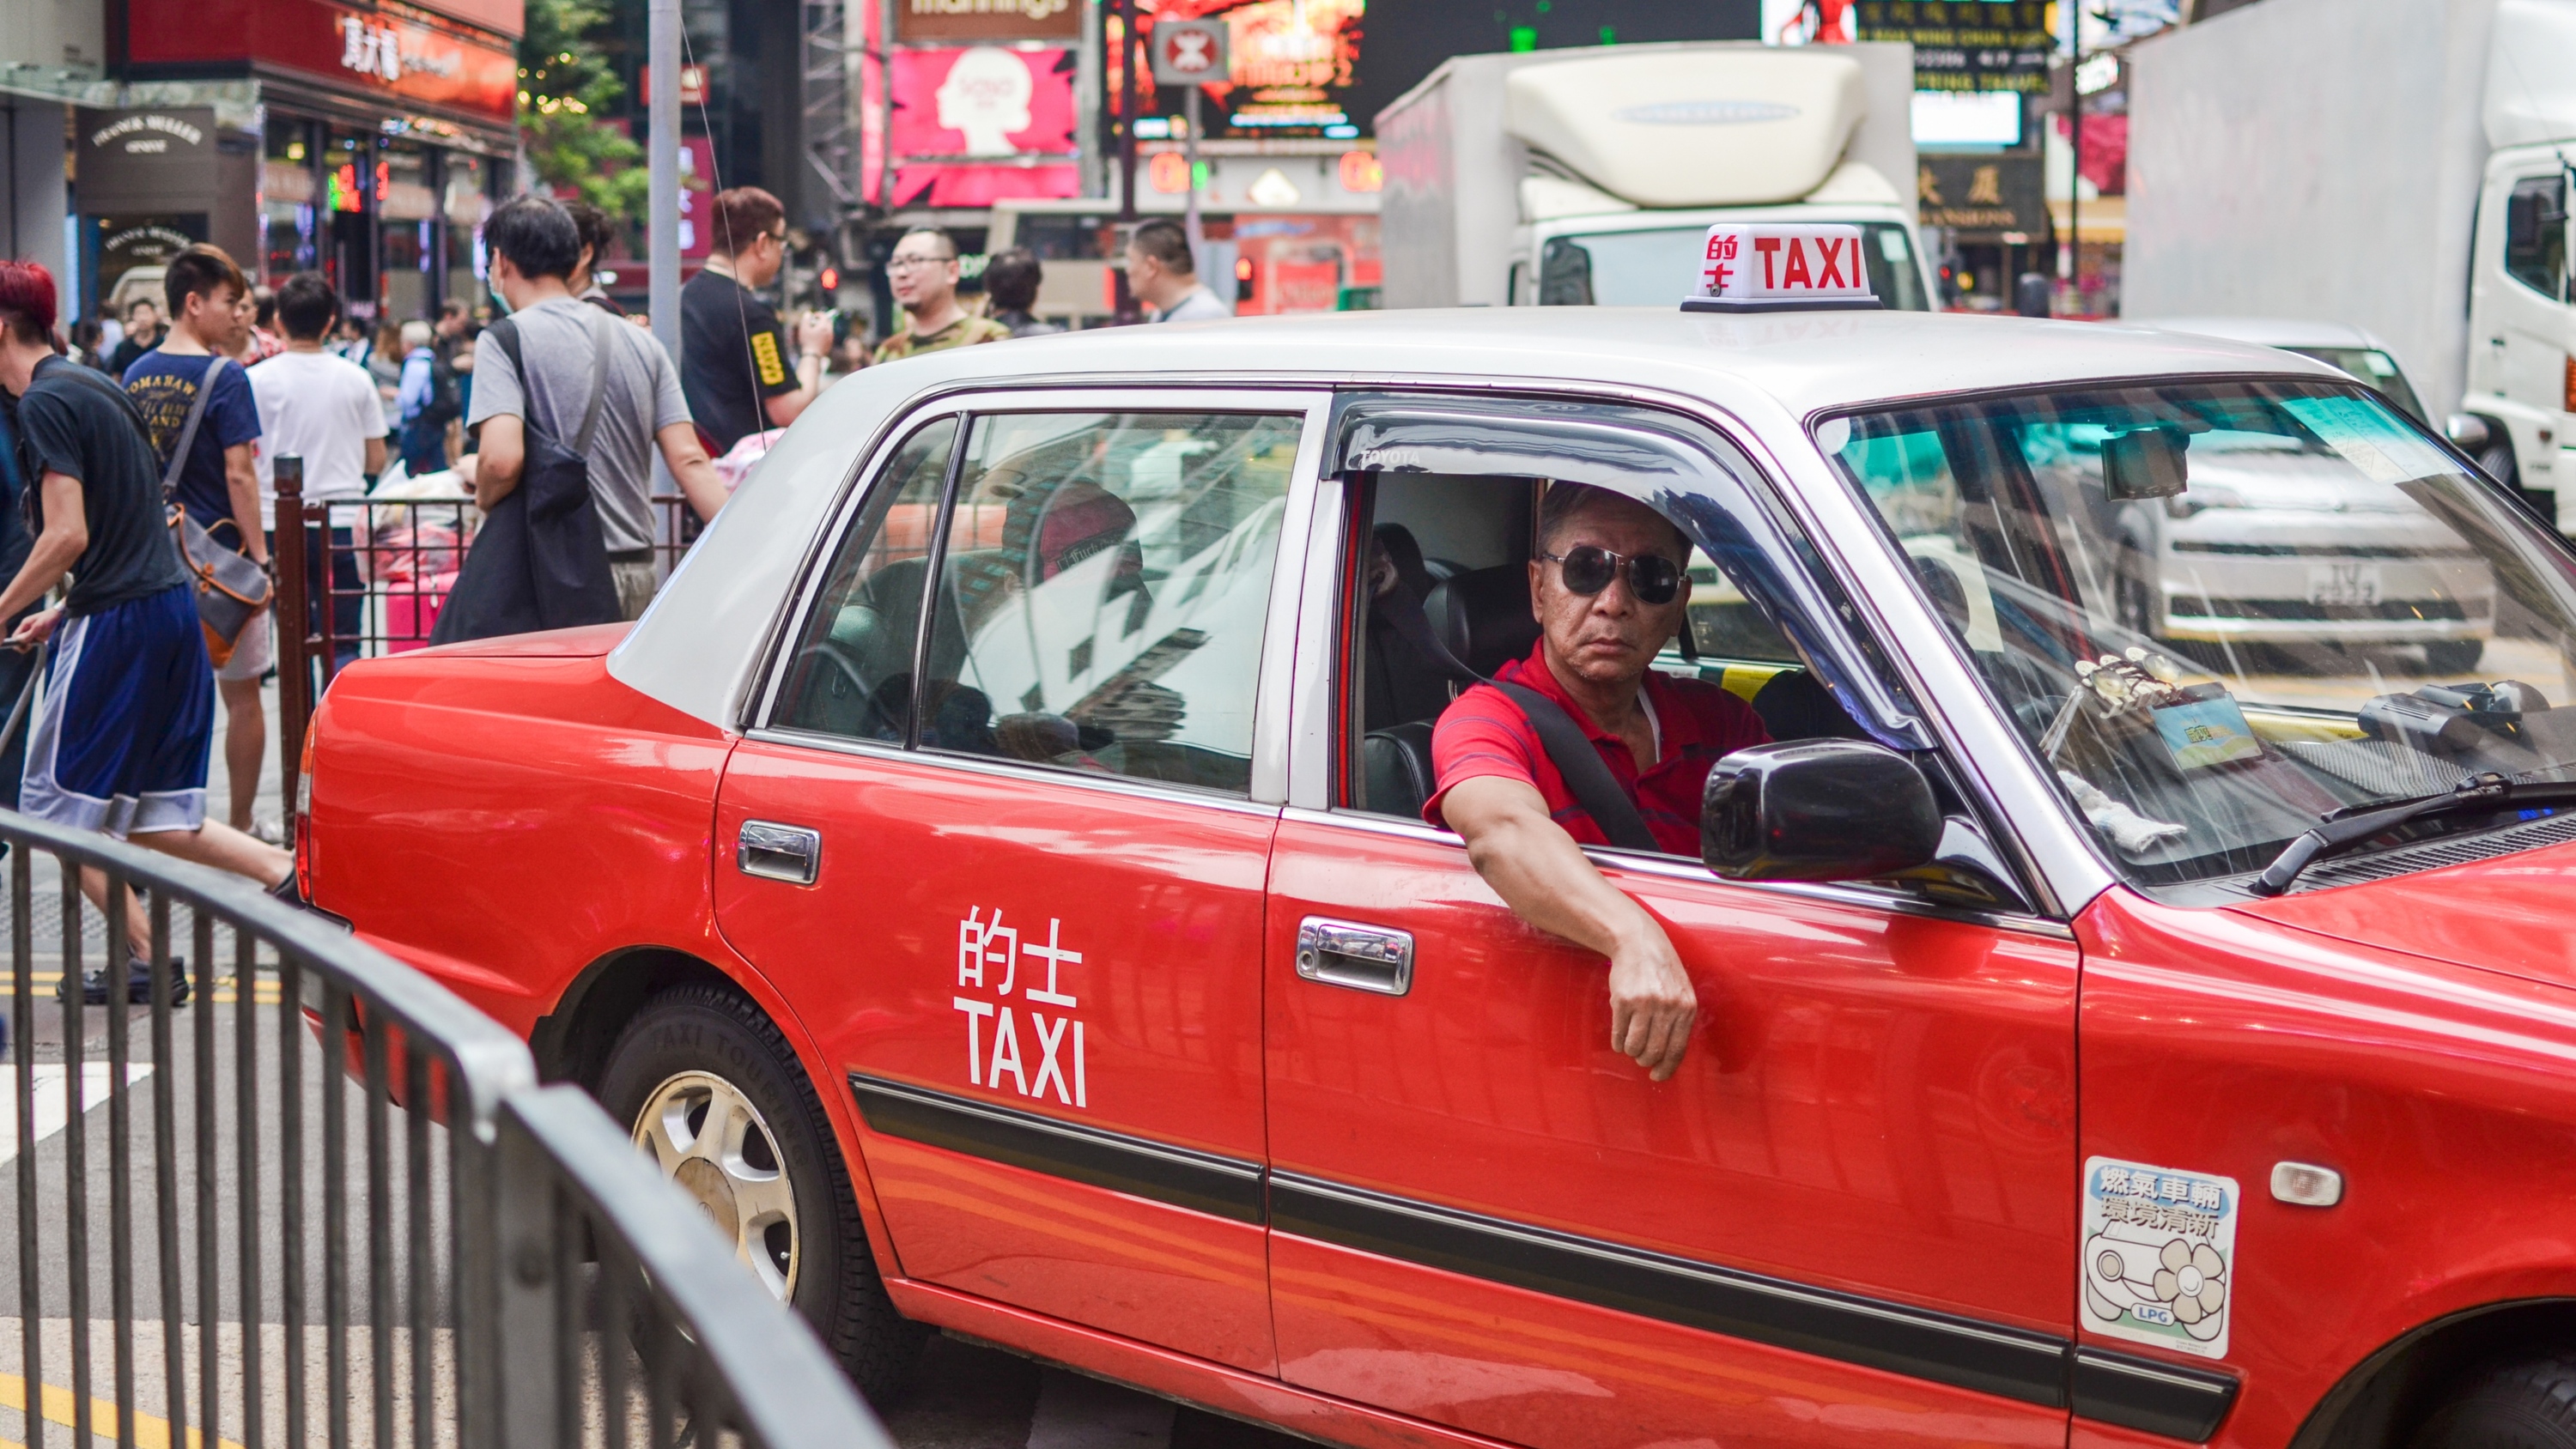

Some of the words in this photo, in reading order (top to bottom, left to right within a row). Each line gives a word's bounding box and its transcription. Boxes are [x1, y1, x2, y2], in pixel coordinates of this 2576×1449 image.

[1704, 234, 1739, 288] 的士
[1754, 238, 1861, 289] TAXI
[127, 374, 198, 403] OMAHAW
[143, 415, 181, 428] AND
[1360, 450, 1420, 464] TOYOTA
[958, 905, 1082, 1008] 的士
[651, 1025, 702, 1050] TAXI
[953, 997, 1086, 1108] TAXI
[2100, 1167, 2223, 1211] 燃氣車輛
[2101, 1197, 2220, 1240] 環境清新
[2138, 1307, 2168, 1323] LPG
